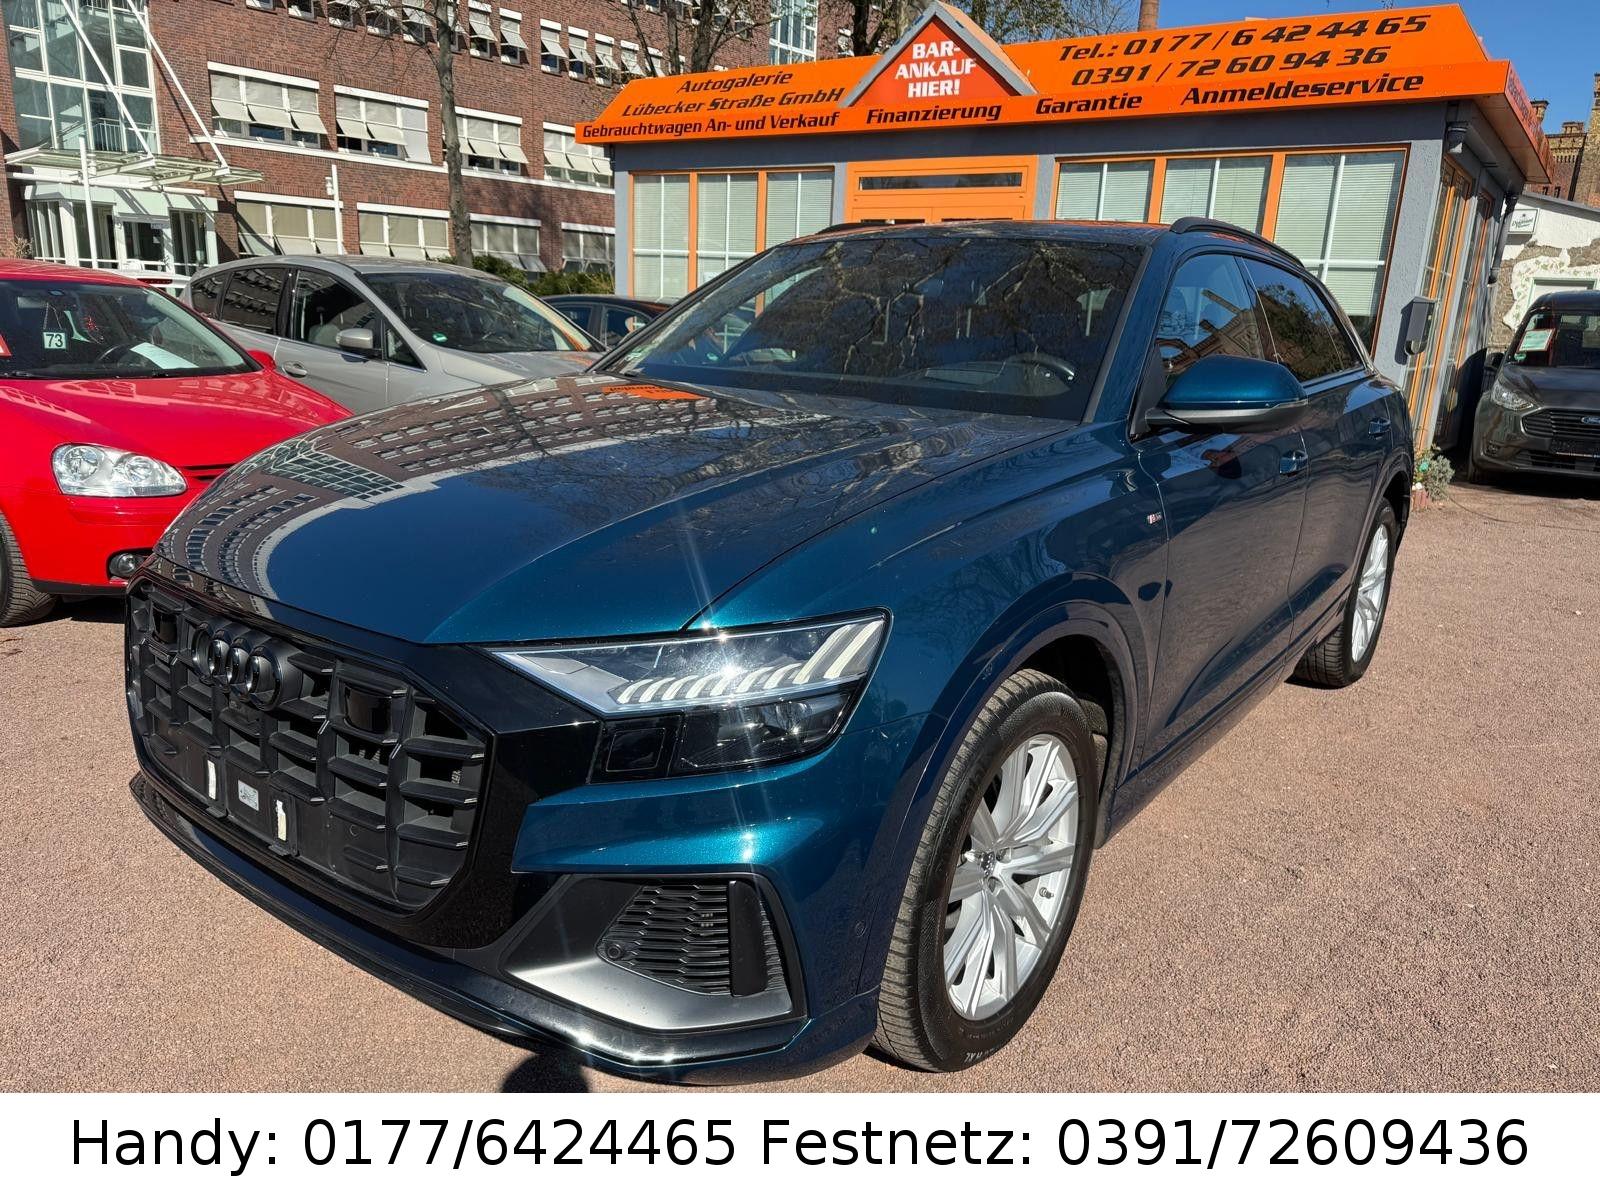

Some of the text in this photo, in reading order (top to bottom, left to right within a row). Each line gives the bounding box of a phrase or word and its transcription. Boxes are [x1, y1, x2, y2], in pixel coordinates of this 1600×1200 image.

[1058, 44, 1119, 61] Tel.:
[1123, 32, 1213, 56] 0177
[1230, 28, 1258, 47] 6
[1261, 25, 1312, 43] 42
[1316, 19, 1370, 39] 44
[1375, 14, 1432, 35] 65
[912, 40, 961, 59] BAR-
[894, 58, 977, 79] ANKAUF
[1072, 64, 1153, 86] 0391
[1176, 59, 1222, 78] 72
[1225, 54, 1276, 75] 60
[1279, 49, 1330, 71] 94
[1336, 45, 1392, 66] 36
[676, 71, 794, 93] Autogalerie
[907, 79, 961, 98] HIER!
[1180, 72, 1425, 106] Anmeldeservice
[621, 87, 846, 117] Lübecker Straße GmbH
[1035, 92, 1143, 115] Garantie
[582, 111, 841, 138] Gebrauchtwagen An- und Verkauf
[866, 105, 1002, 124] Finanzierung
[46, 333, 63, 347] 73
